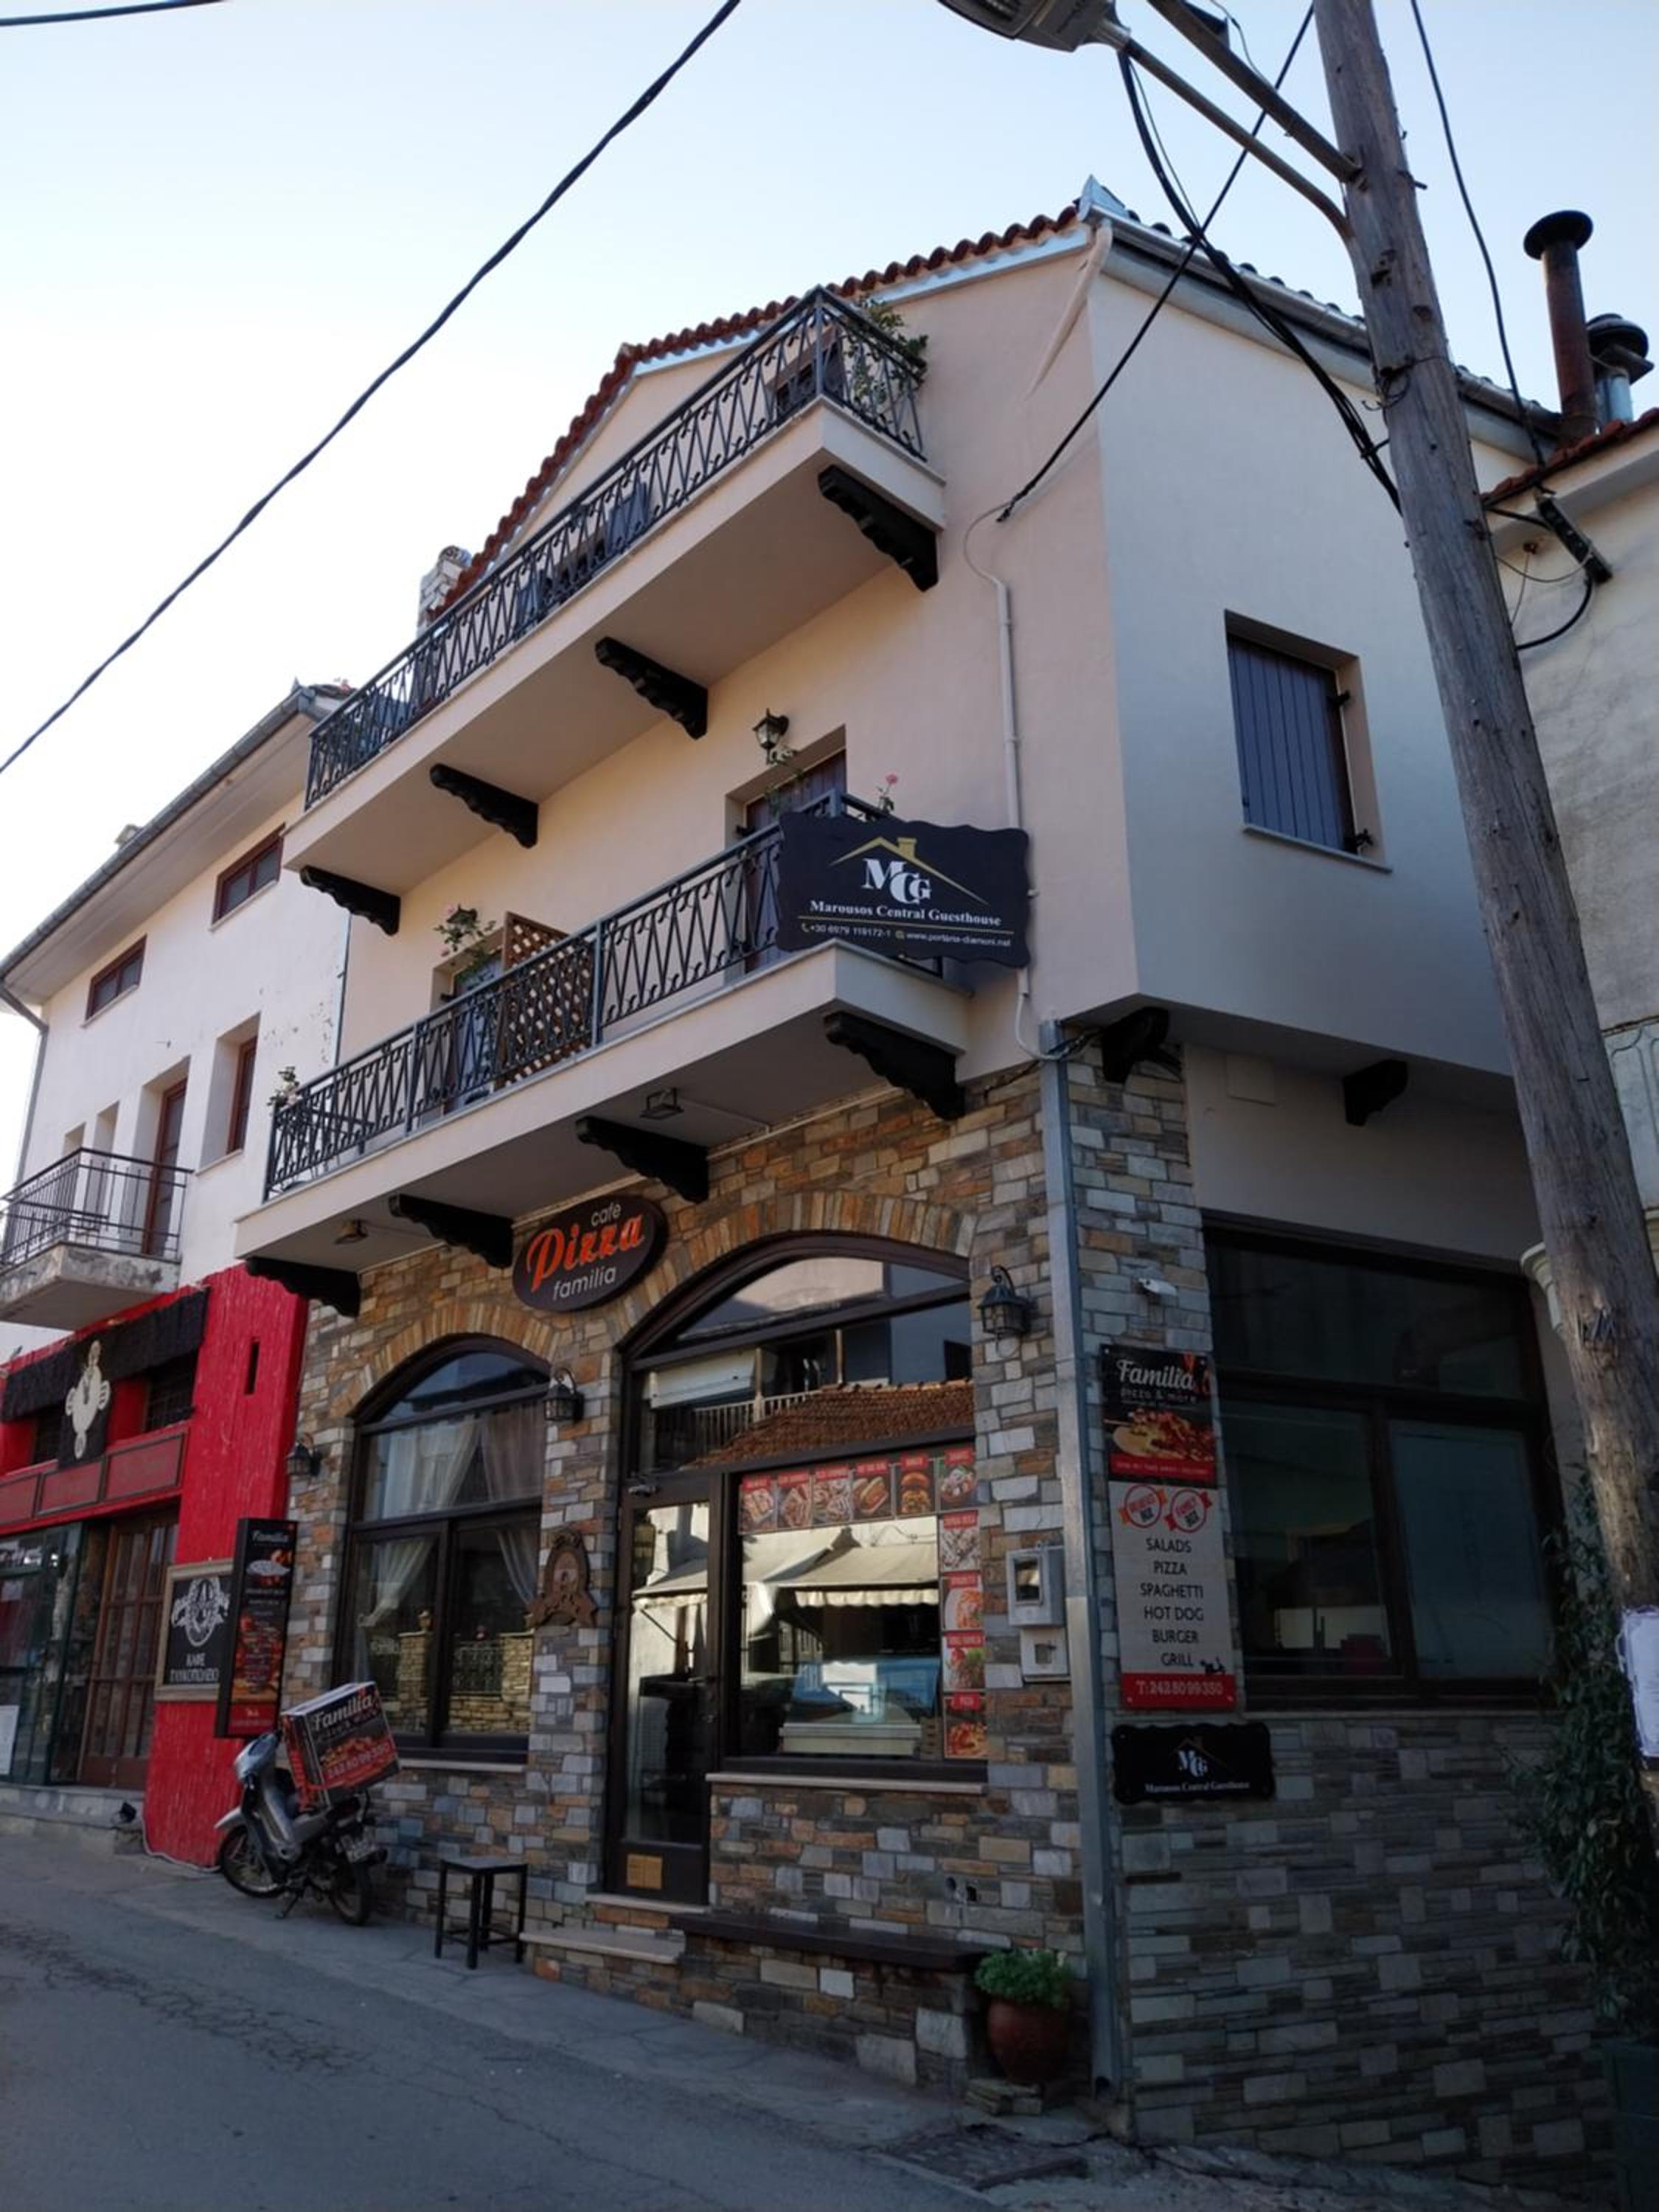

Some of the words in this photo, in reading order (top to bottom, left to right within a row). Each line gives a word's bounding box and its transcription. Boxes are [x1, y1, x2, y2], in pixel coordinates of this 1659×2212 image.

[810, 900, 874, 916] Marousos
[876, 904, 925, 920] Central
[928, 908, 1002, 926] Guesthouse
[591, 1203, 622, 1226] cafe
[526, 1214, 645, 1292] Pizza
[553, 1266, 617, 1301] familia
[1116, 1358, 1195, 1391] Familia
[1146, 1537, 1192, 1553] SALADS
[1153, 1560, 1188, 1576] PIZZA
[1140, 1582, 1204, 1599] SPAGHETTI
[1144, 1606, 1172, 1620] HOT
[1175, 1607, 1204, 1621] DOG
[1152, 1629, 1200, 1644] BURGER
[1161, 1653, 1194, 1667] GRILL
[313, 1694, 373, 1732] Familia
